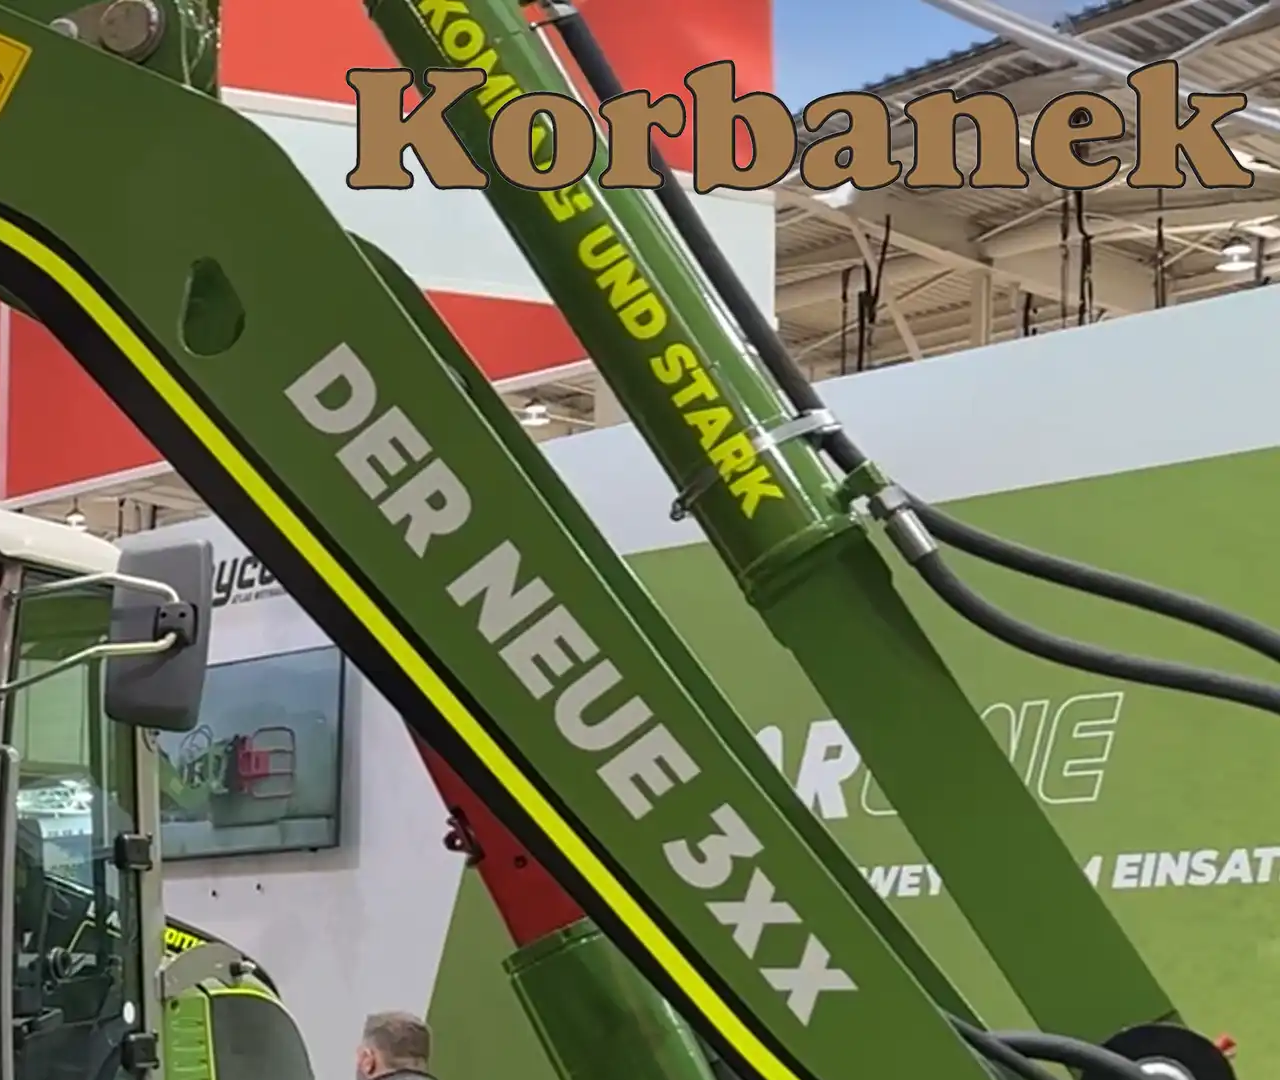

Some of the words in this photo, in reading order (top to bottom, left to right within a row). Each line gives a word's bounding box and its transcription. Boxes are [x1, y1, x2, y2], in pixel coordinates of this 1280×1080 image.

[579, 223, 667, 339] UND
[650, 343, 785, 518] STARK
[284, 342, 472, 558] DER
[446, 540, 701, 820] NEUE
[663, 803, 858, 1026] 3XX
[1111, 847, 1280, 889] EINSAT
